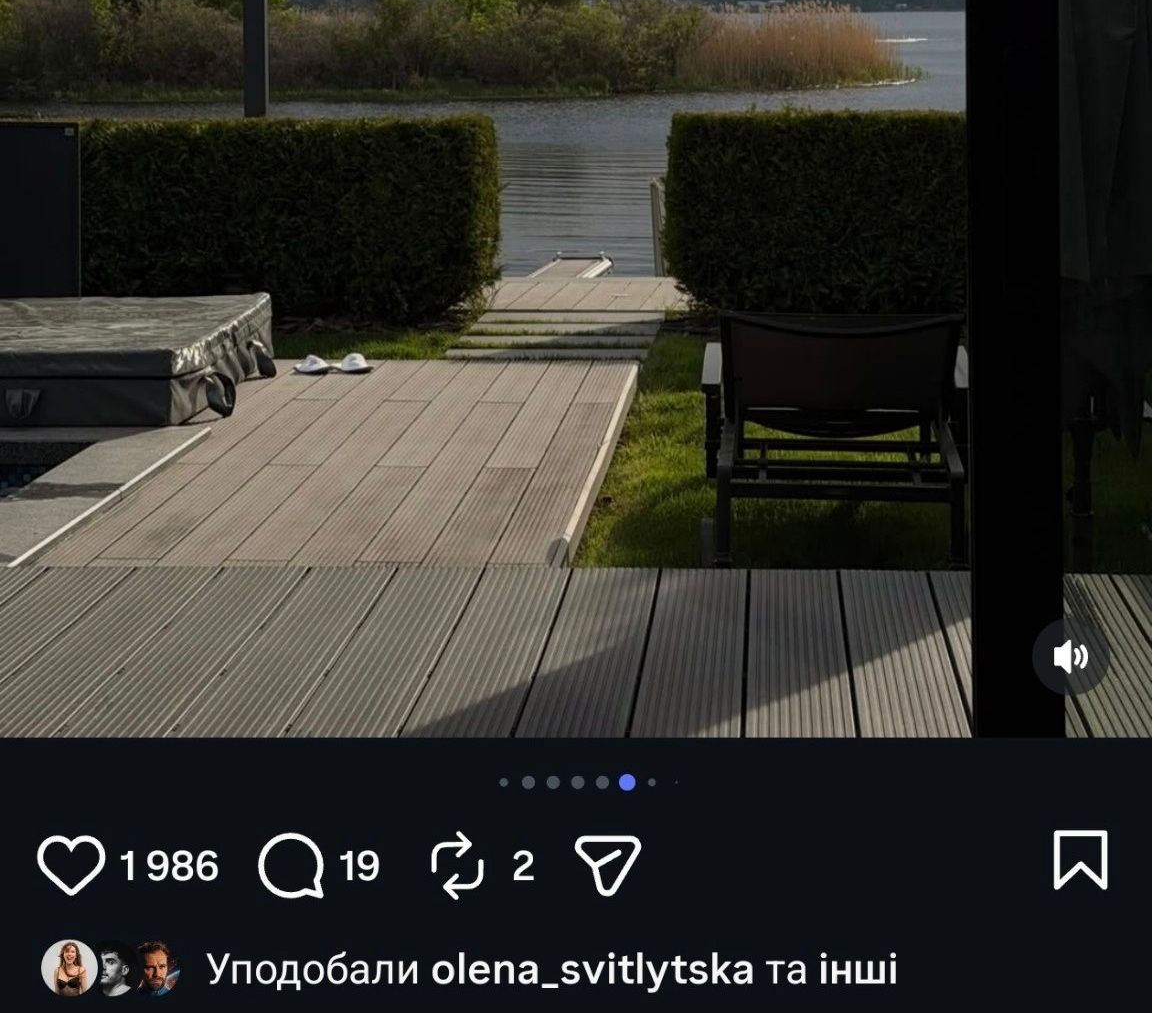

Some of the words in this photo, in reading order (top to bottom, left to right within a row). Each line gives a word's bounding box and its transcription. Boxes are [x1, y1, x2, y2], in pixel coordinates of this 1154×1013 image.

[339, 849, 380, 882] 19
[513, 849, 535, 881] 2
[206, 950, 419, 991] Уподобали
[431, 951, 755, 994] olena_svitlytska
[765, 960, 808, 985] та
[820, 952, 897, 985] інші
